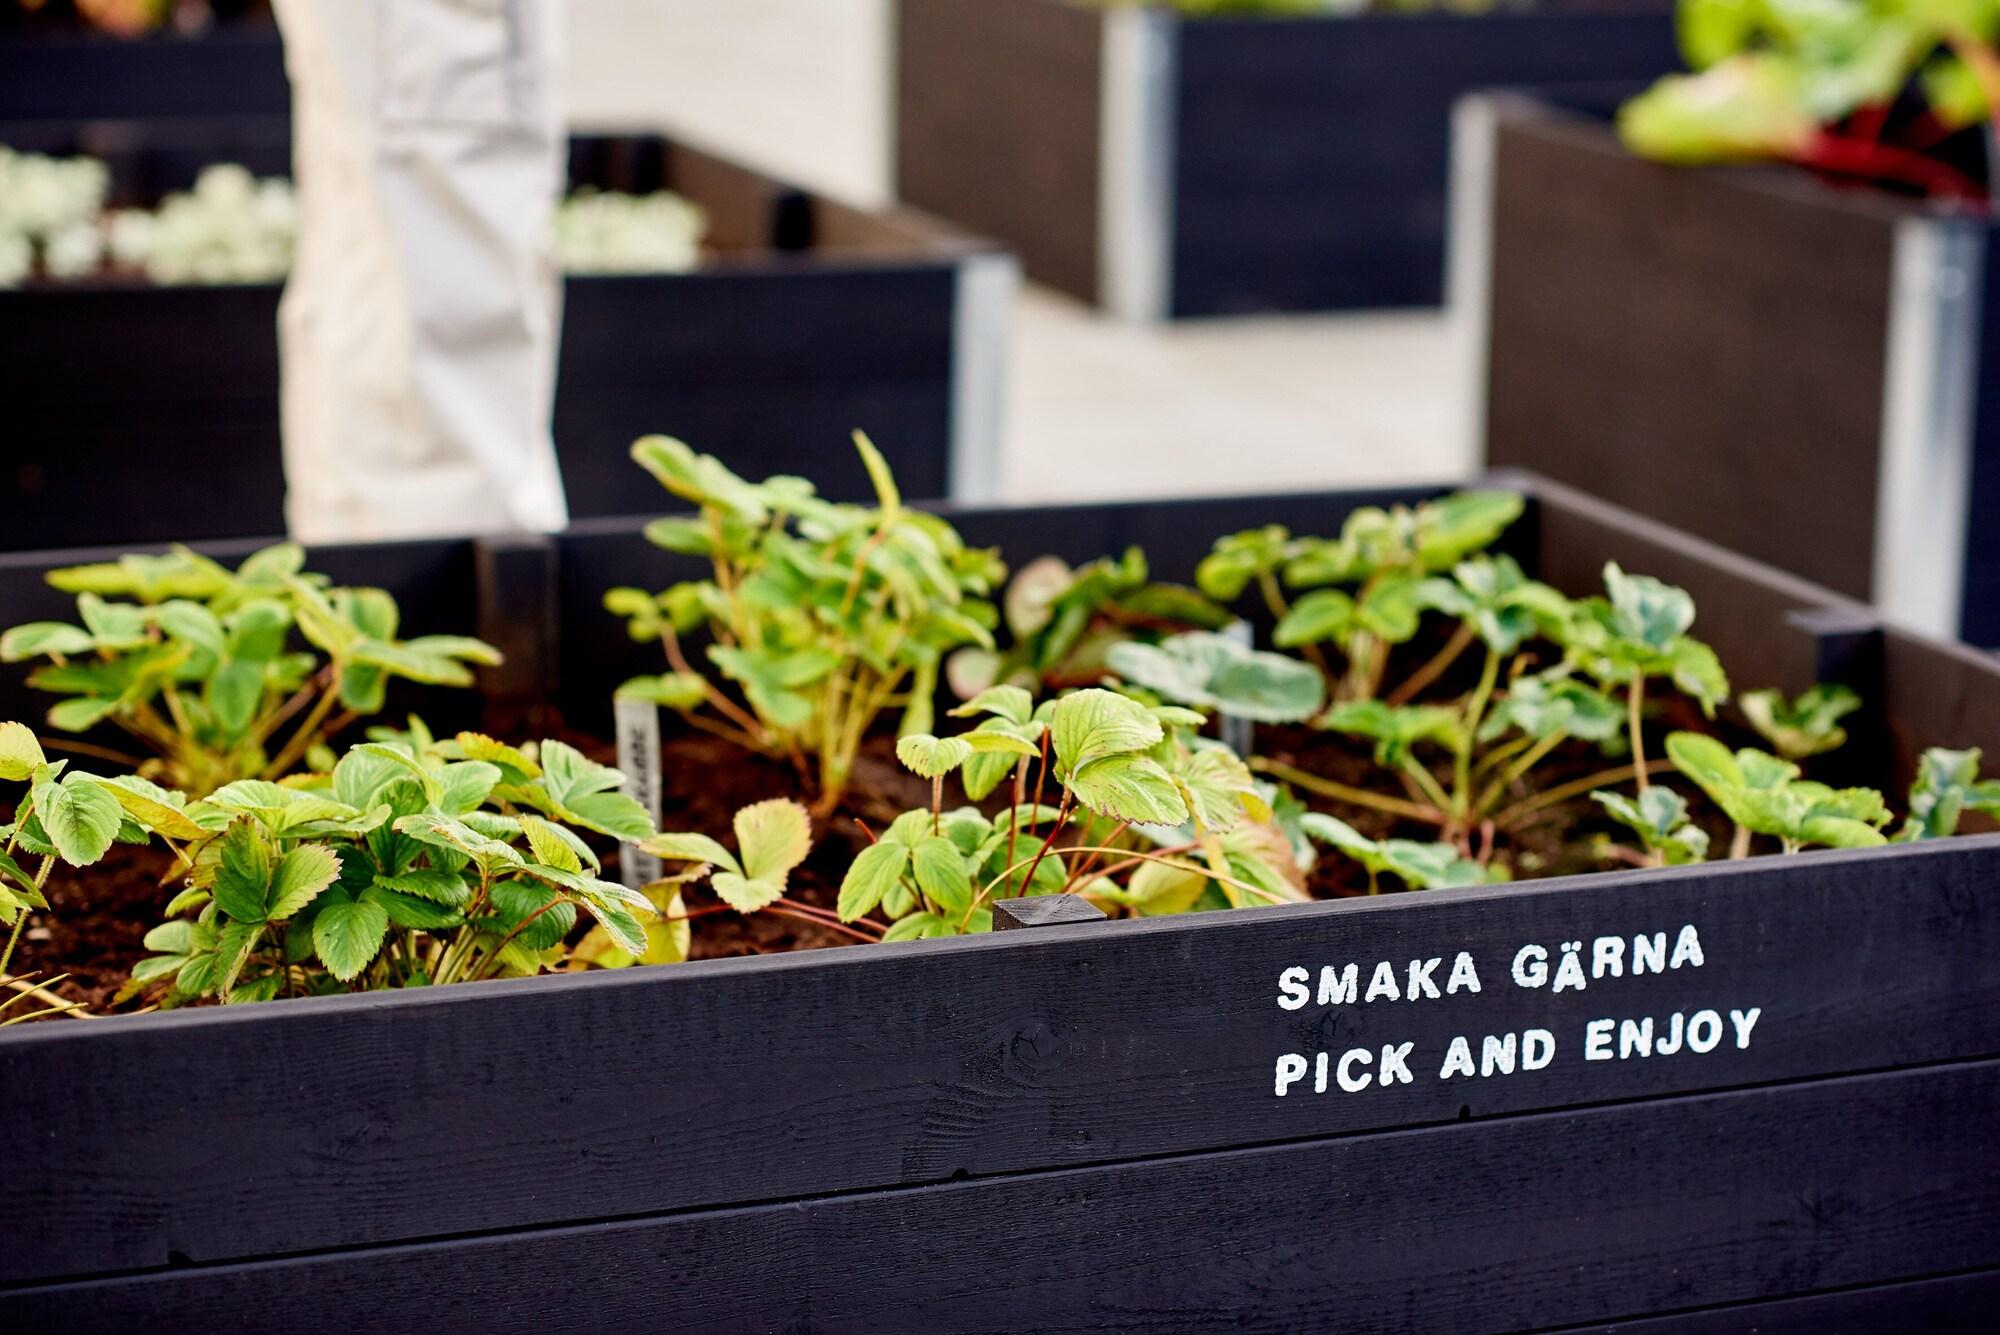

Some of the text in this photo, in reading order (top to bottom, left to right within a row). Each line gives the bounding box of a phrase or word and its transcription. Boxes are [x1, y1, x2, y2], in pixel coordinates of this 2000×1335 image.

[1277, 925, 1705, 1011] SMAKA GÄRNA
[1275, 1008, 1762, 1097] PICK AND ENJOY
